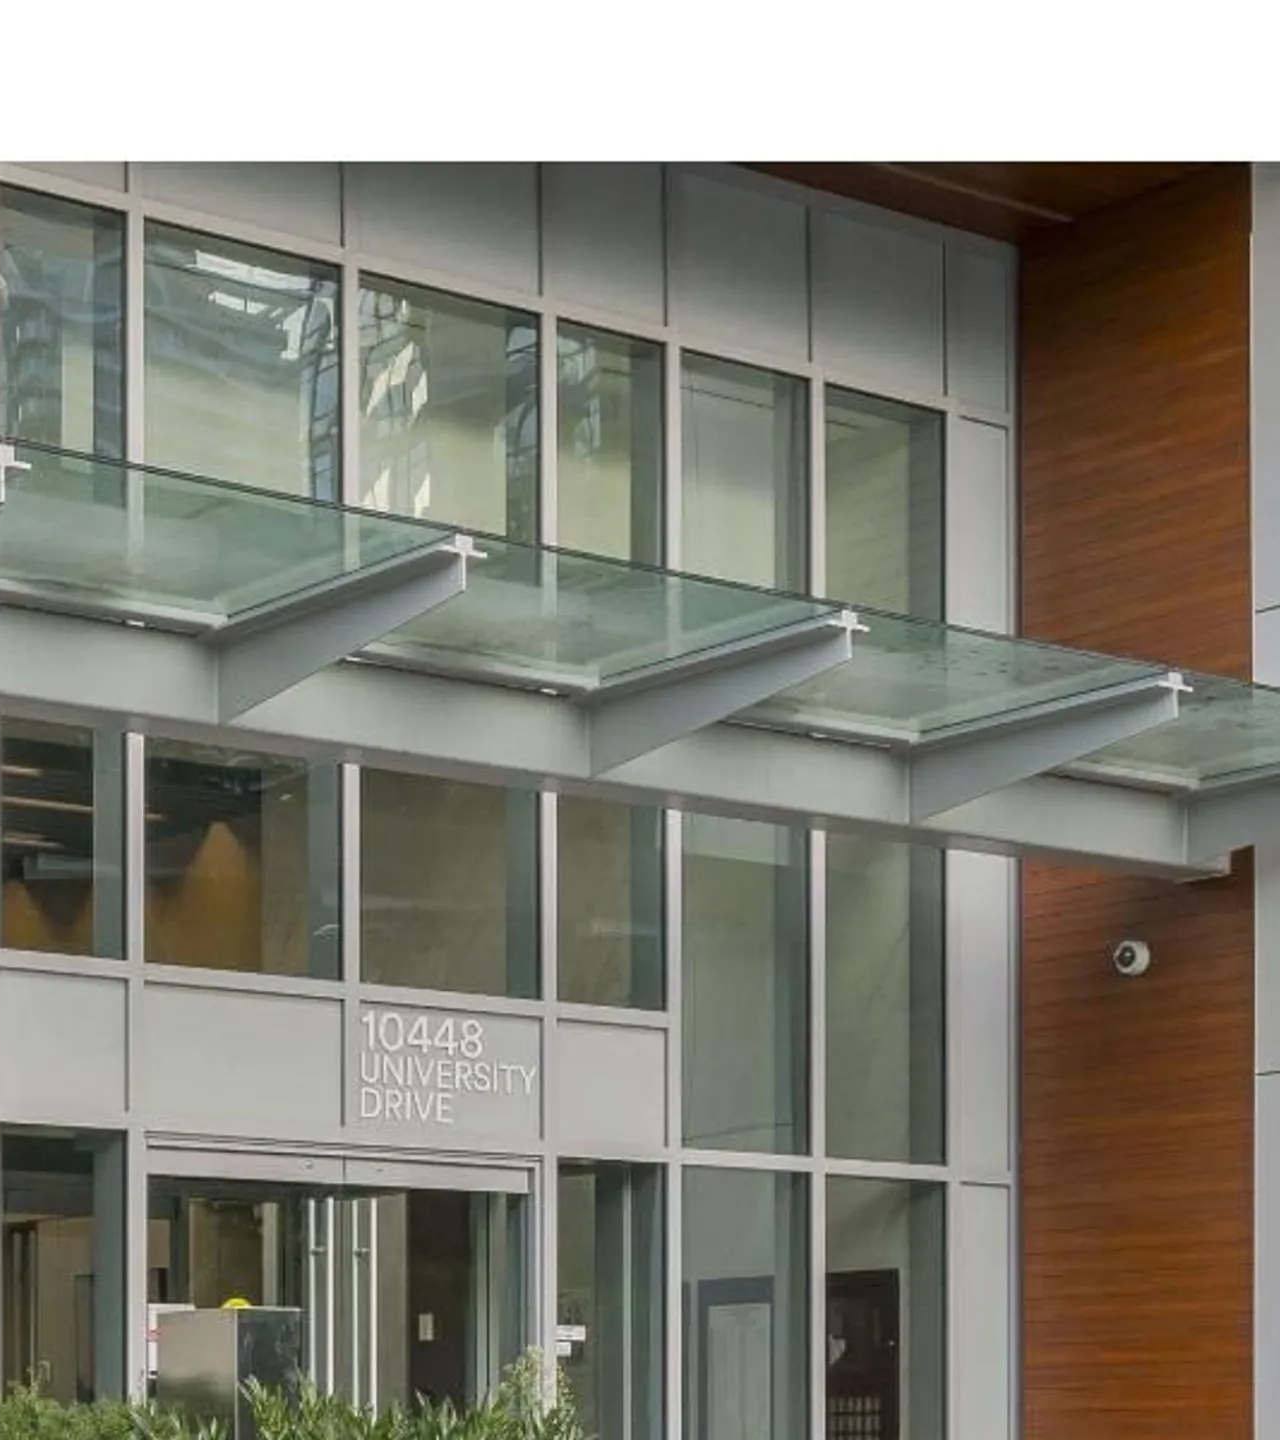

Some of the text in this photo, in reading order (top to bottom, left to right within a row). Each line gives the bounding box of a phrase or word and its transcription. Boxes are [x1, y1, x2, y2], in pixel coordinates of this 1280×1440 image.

[361, 1010, 483, 1059] 10448
[361, 1051, 536, 1095] UNIVERSITY
[361, 1087, 454, 1123] DRIVE
